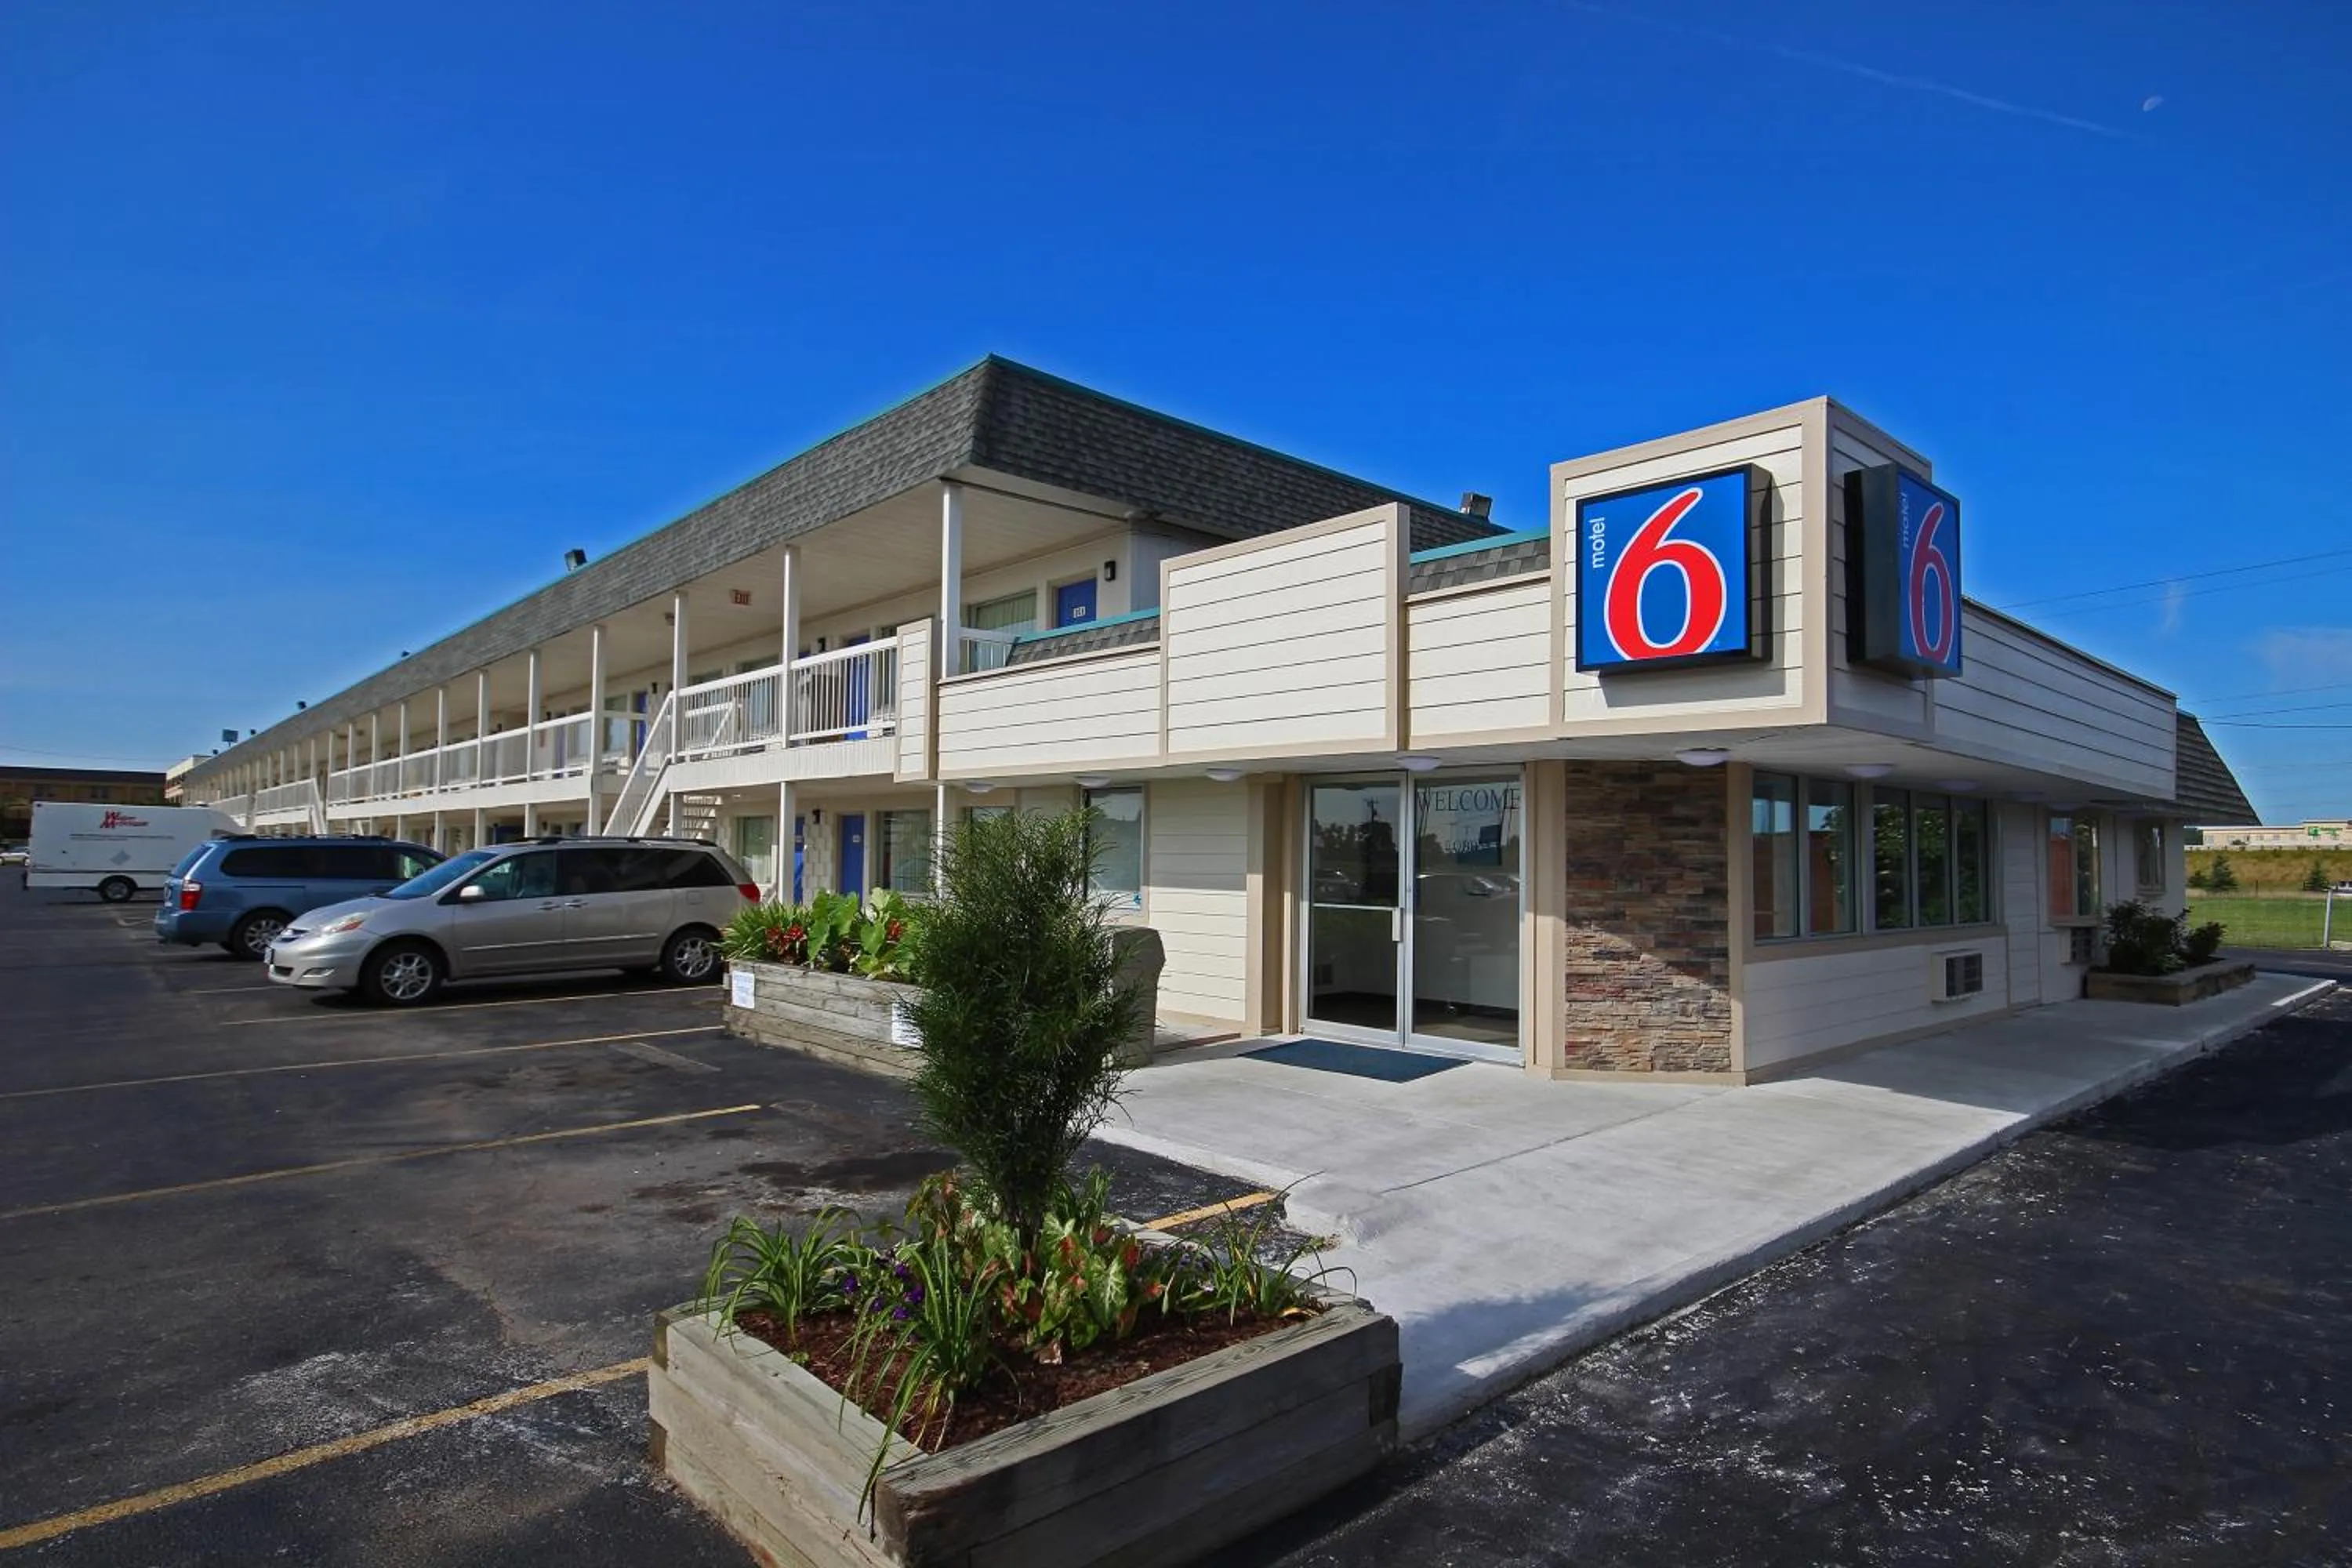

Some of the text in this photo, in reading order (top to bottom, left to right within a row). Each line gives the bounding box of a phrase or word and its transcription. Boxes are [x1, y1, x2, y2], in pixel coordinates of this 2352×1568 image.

[1588, 487, 1727, 661] motel 6
[1909, 501, 1955, 665] 6
[1417, 787, 1521, 813] WELCOME
